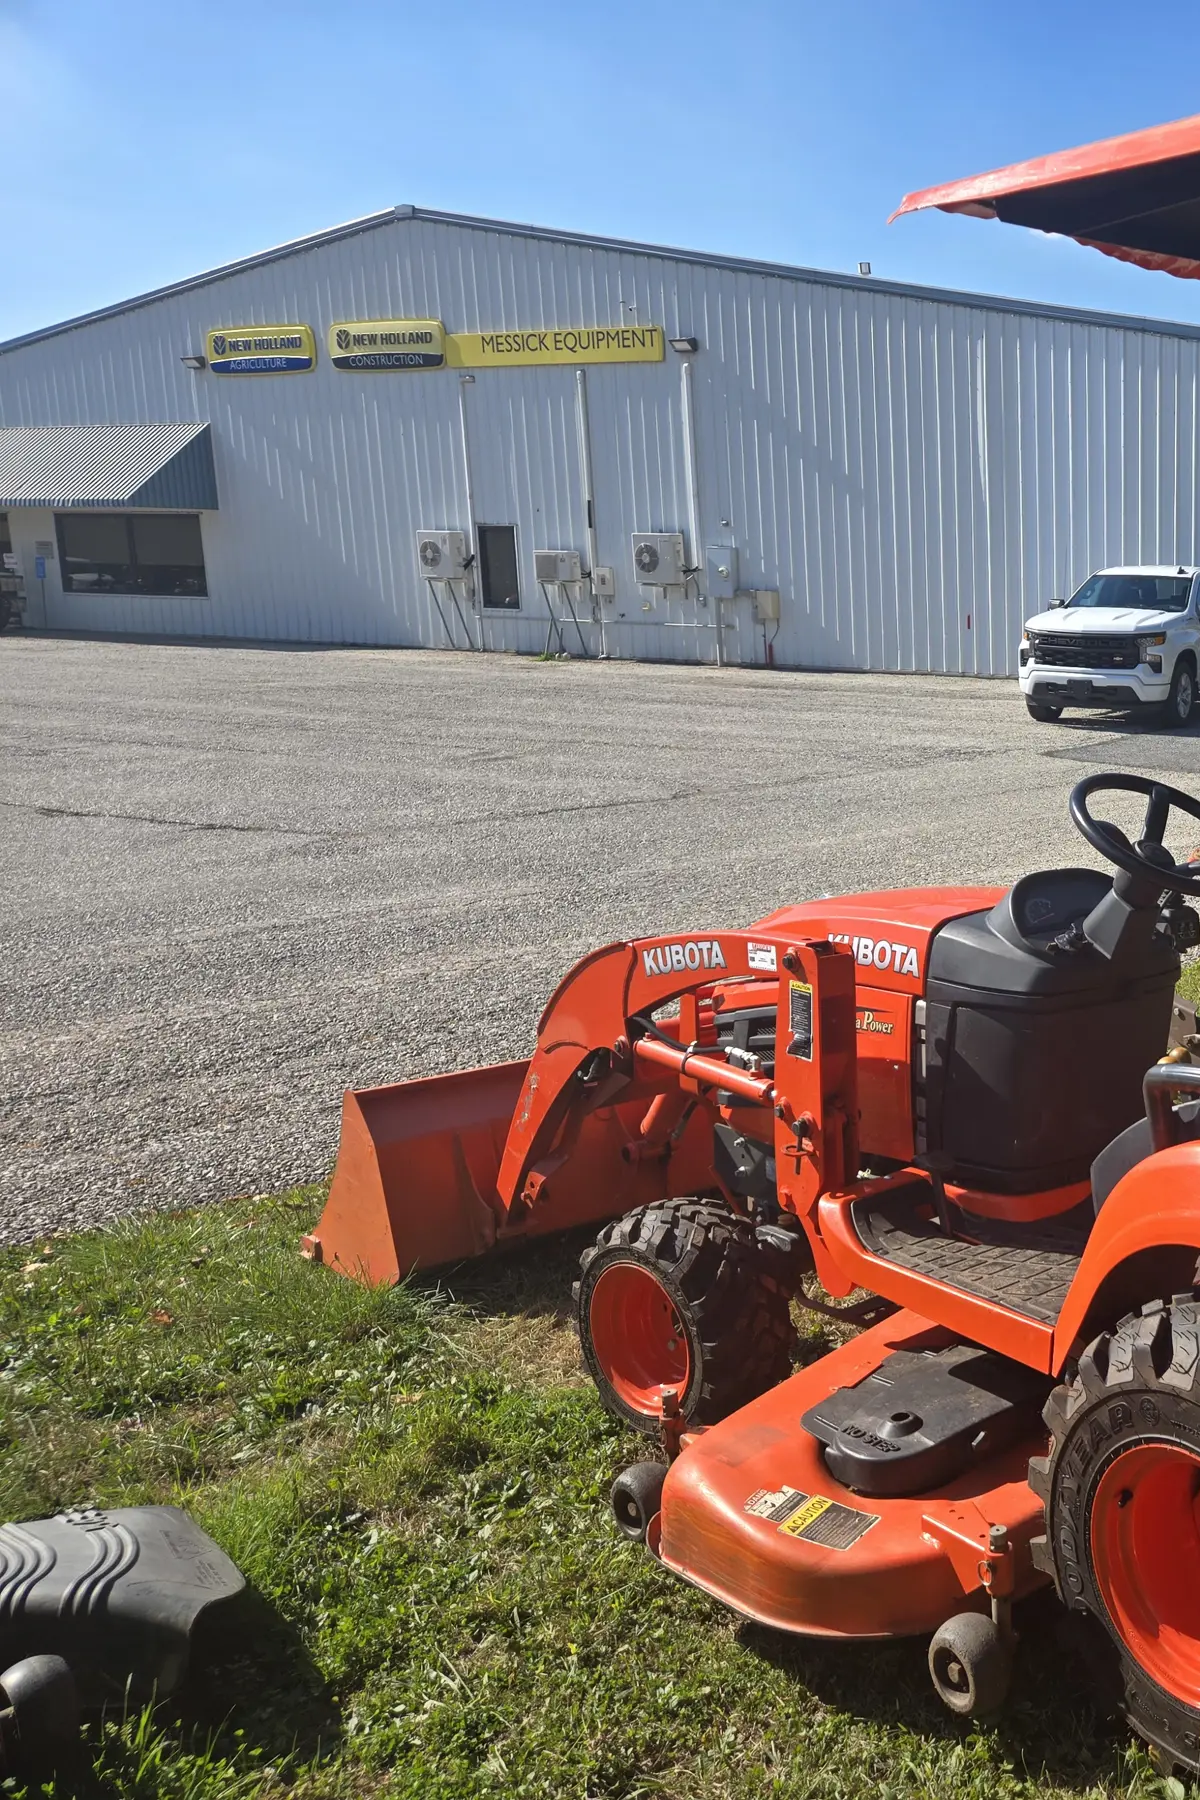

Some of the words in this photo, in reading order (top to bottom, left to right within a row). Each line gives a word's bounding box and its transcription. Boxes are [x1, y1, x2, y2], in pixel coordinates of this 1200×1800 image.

[228, 338, 252, 352] NEW
[254, 335, 302, 350] HOLLAND
[353, 333, 378, 346] NEW
[380, 331, 433, 345] HOLLAND
[481, 333, 550, 353] MESSICK
[553, 329, 658, 353] EQUIPMENT
[229, 357, 288, 370] AGRICULTURE
[349, 354, 424, 367] CONSTRUCTION
[642, 940, 728, 977] KUBOTA
[841, 1424, 867, 1439] NO
[862, 1432, 901, 1453] STEP
[792, 1497, 829, 1529] CAUTION
